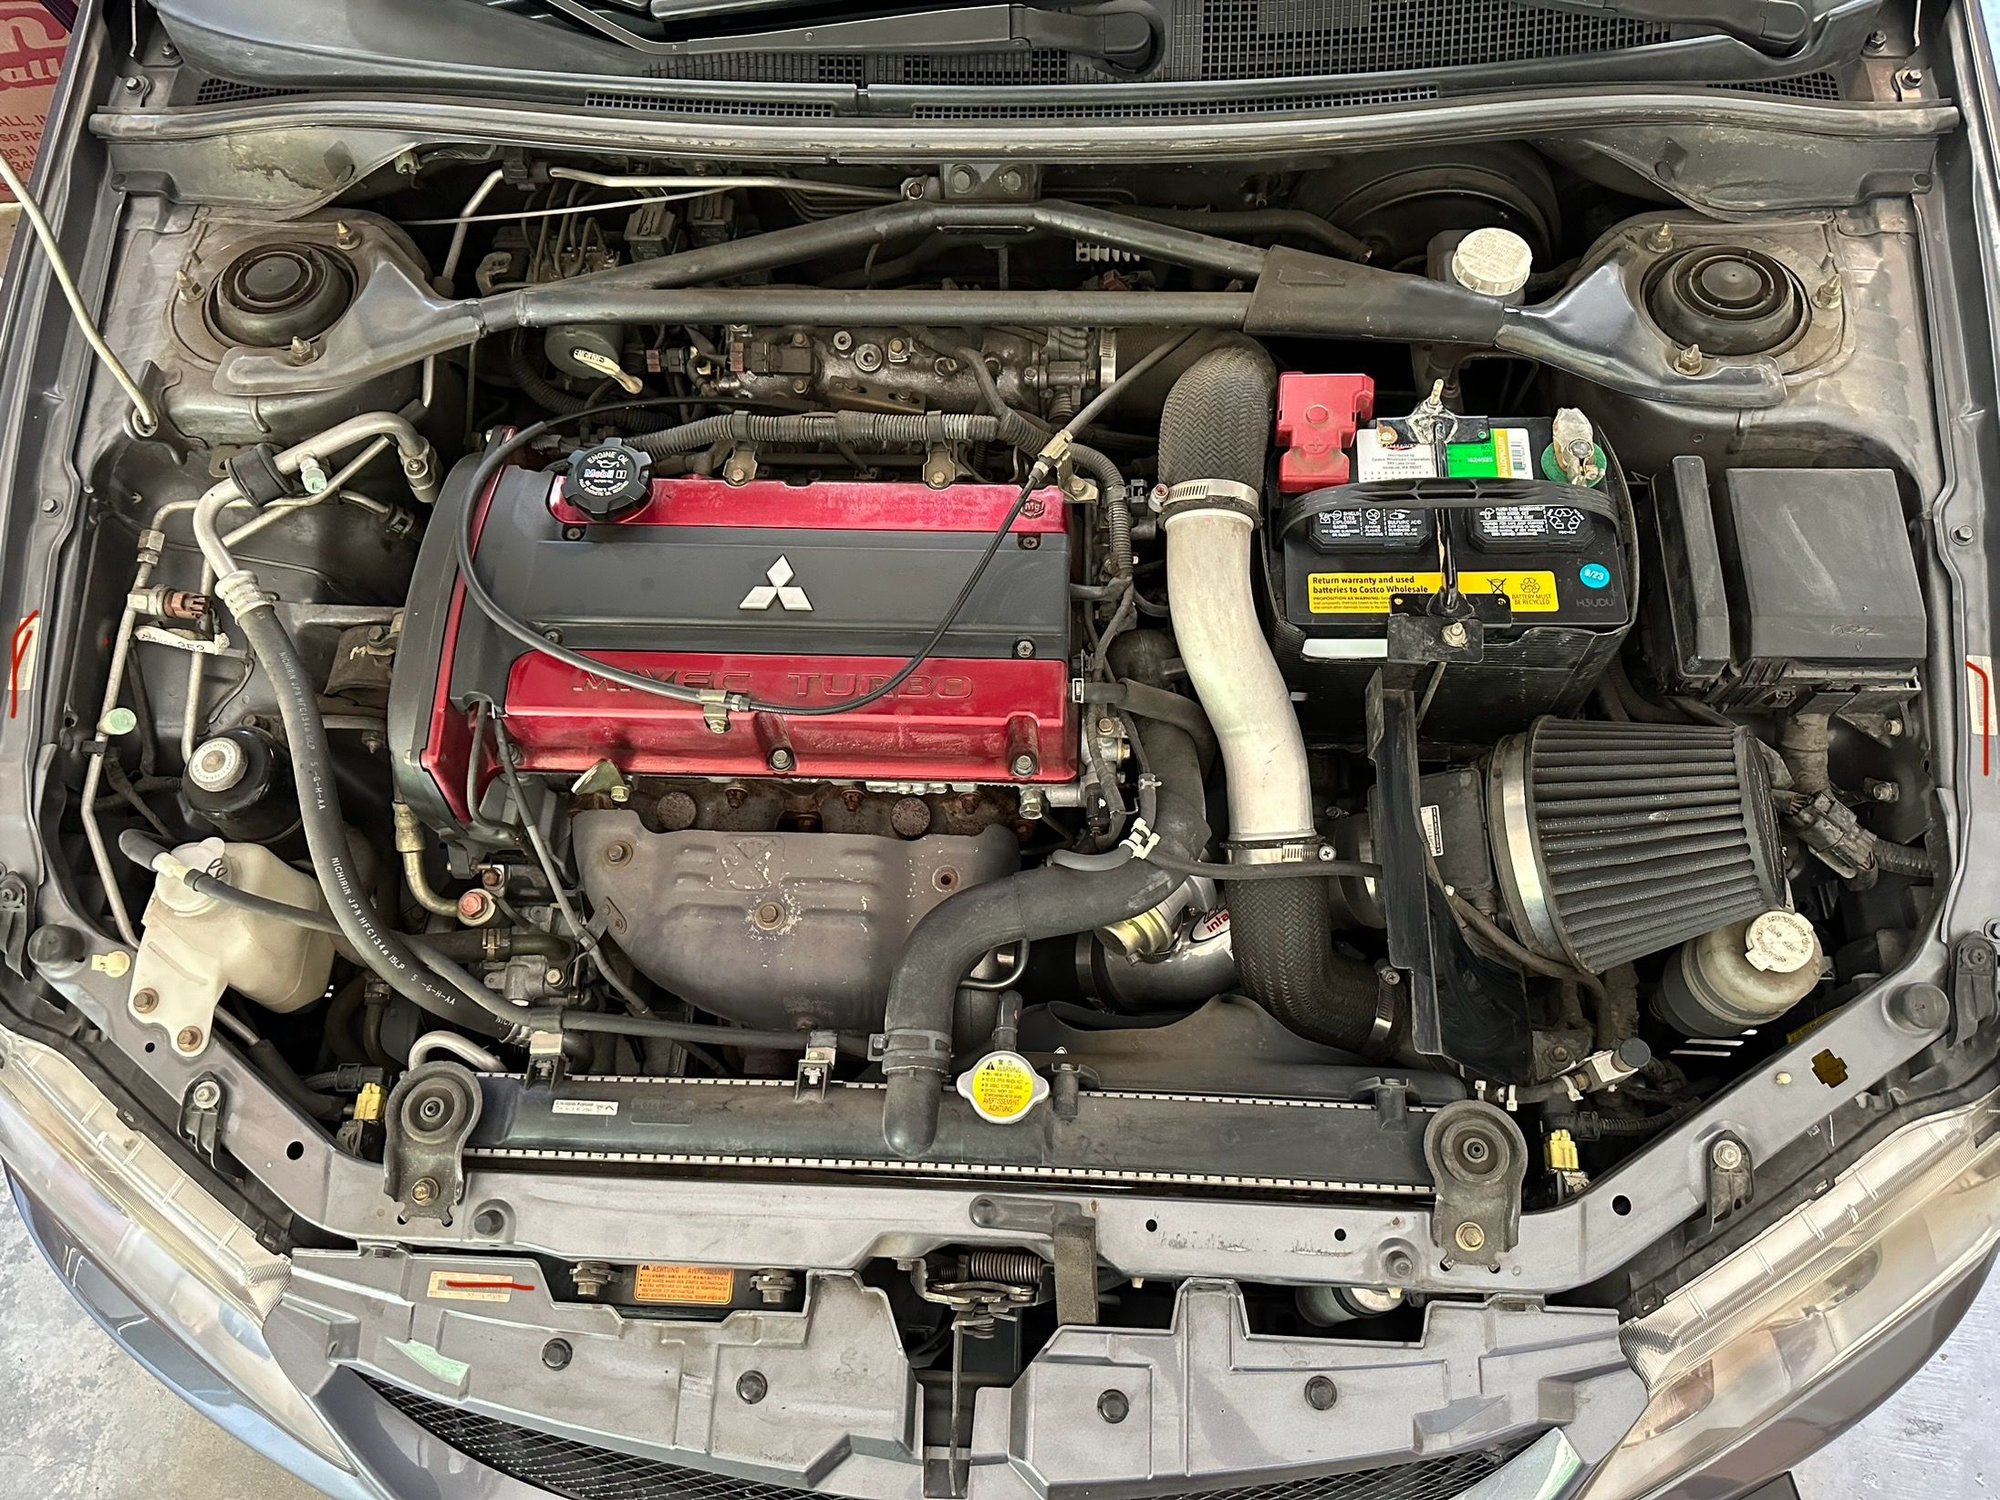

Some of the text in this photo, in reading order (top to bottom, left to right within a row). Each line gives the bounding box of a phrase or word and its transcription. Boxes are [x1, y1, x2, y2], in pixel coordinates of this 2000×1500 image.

[587, 451, 629, 465] ENGINE OIL
[584, 468, 615, 479] Mobil
[1312, 575, 1415, 586] Return warranty and used
[1312, 585, 1429, 594] batteries to Costco Wholesale
[787, 672, 973, 700] TURBO
[330, 856, 352, 895] NICHIRIN
[347, 897, 362, 917] JPN
[387, 954, 406, 970] 15LP
